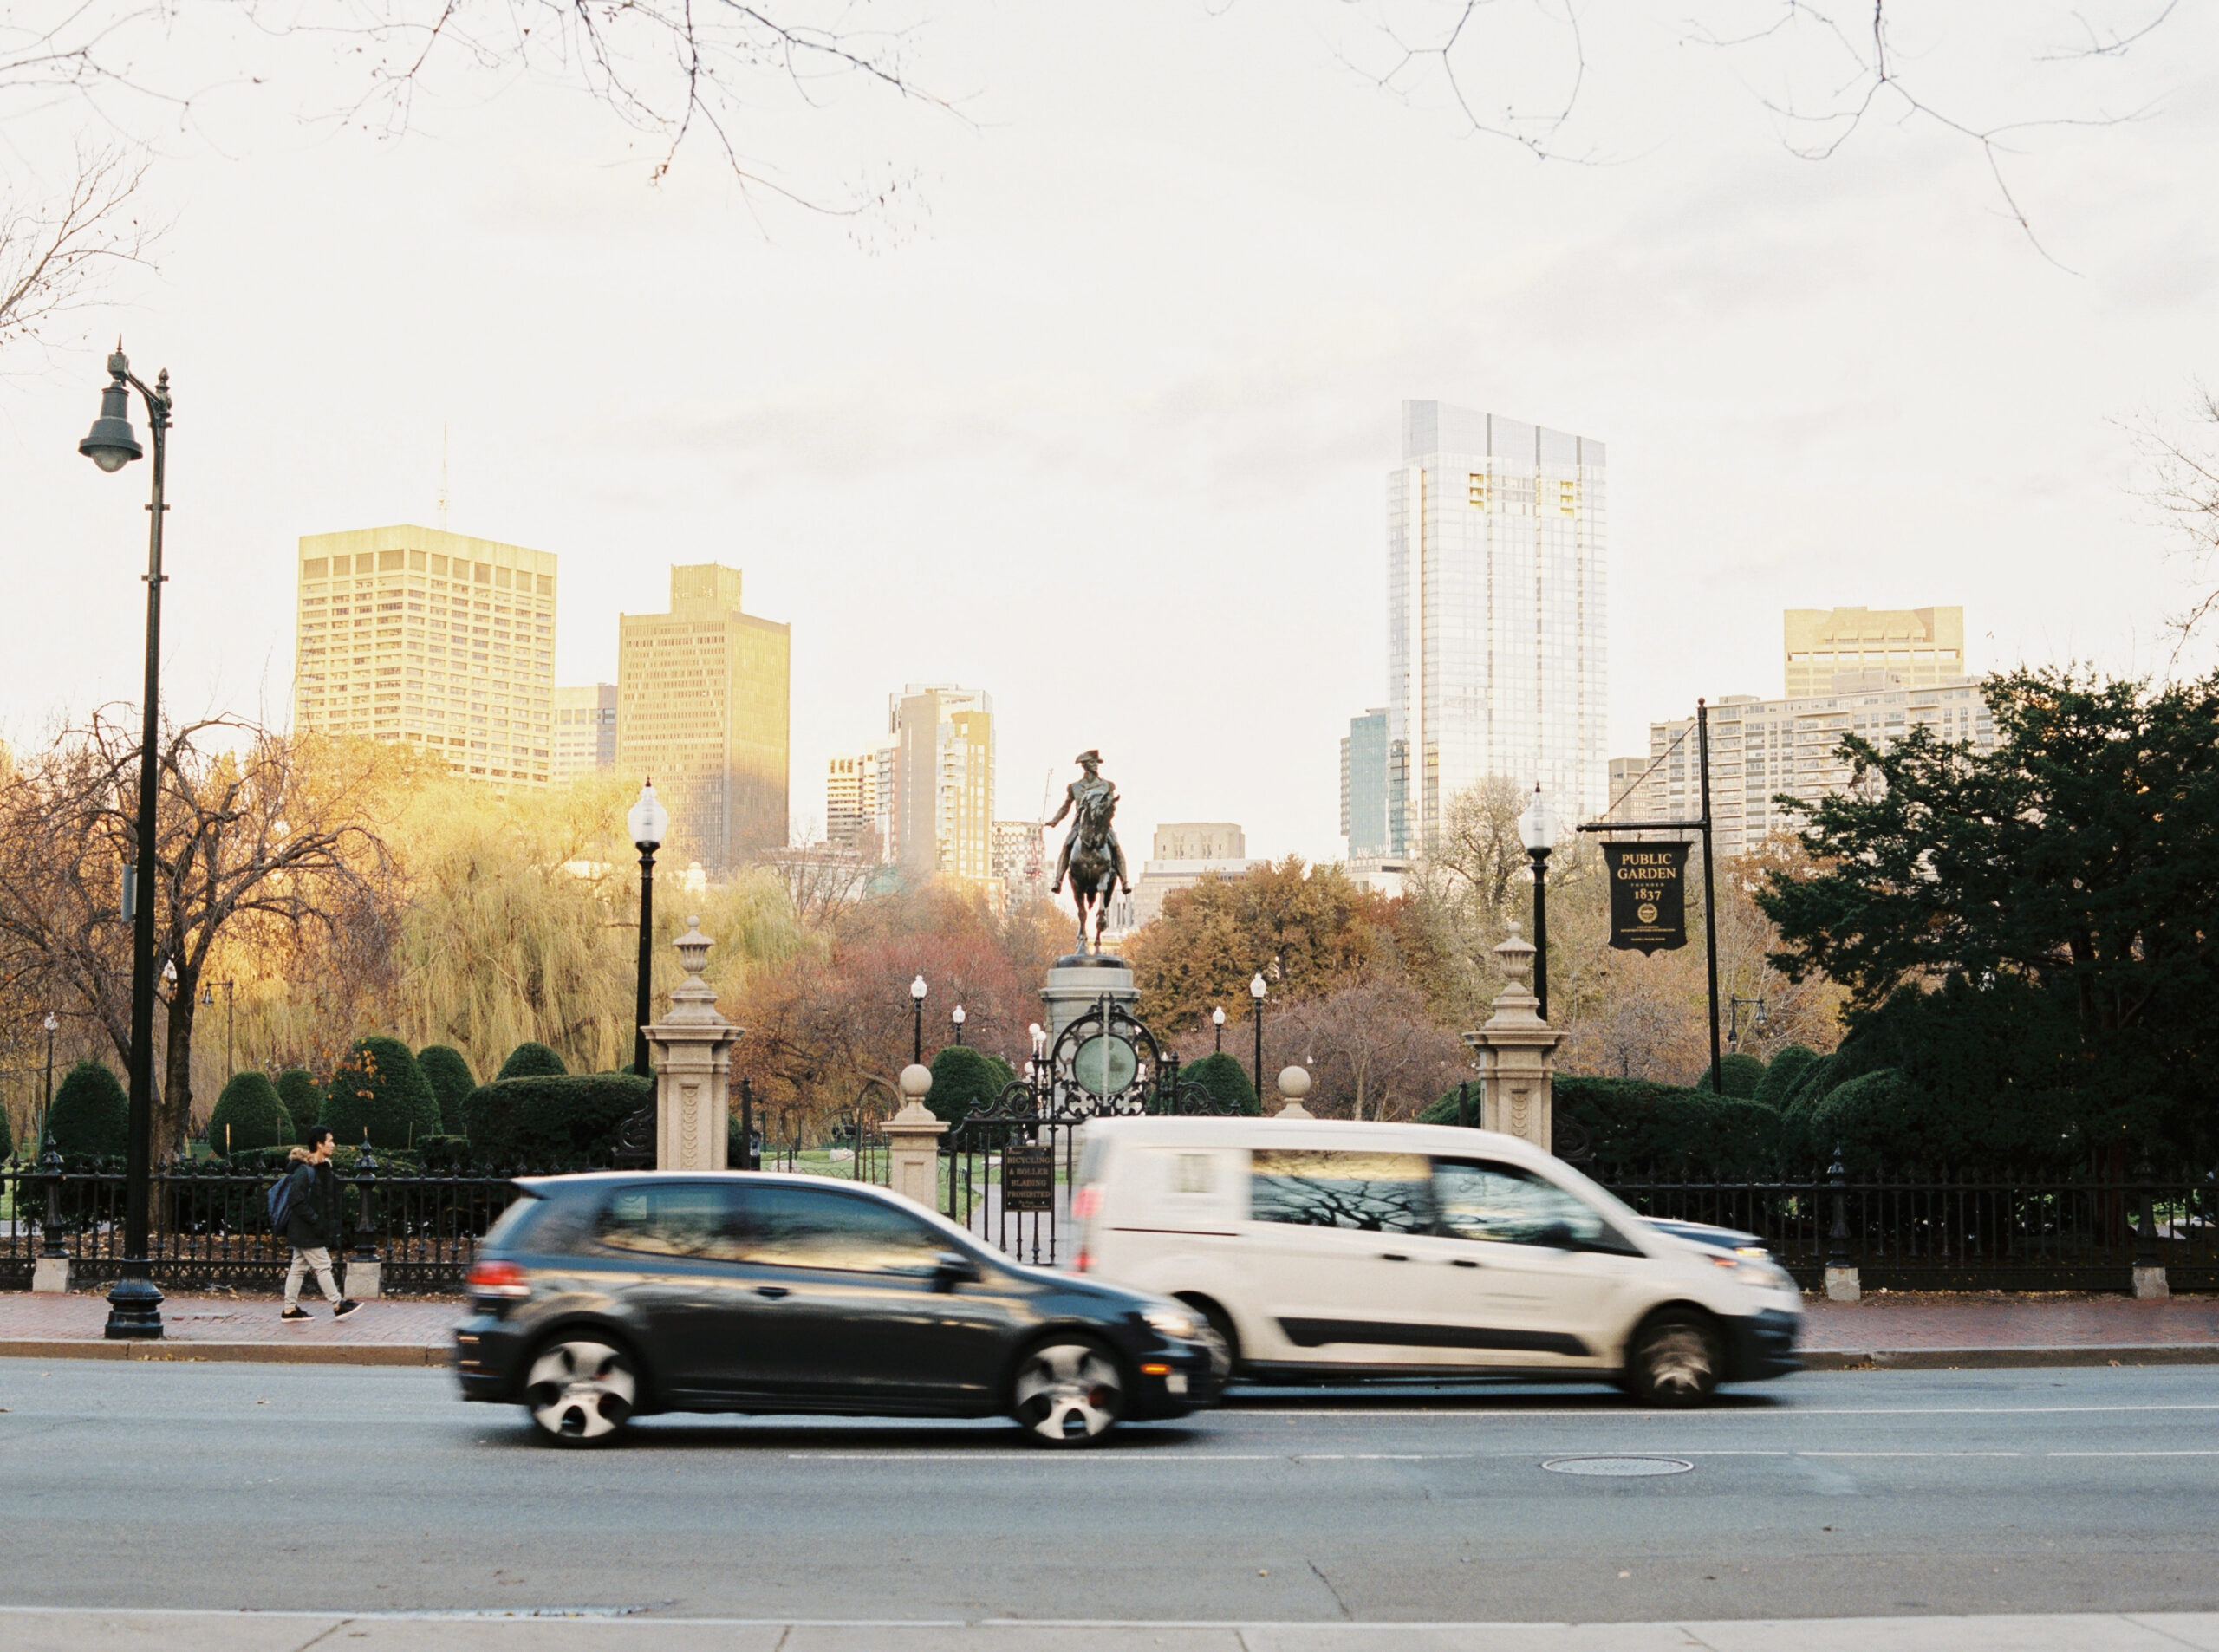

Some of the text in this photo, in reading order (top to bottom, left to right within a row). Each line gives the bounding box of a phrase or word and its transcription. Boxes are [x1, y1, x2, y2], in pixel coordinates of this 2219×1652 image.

[1622, 854, 1672, 865] PUBLIC
[1617, 868, 1676, 880] GARDEN
[1635, 888, 1662, 901] 1837
